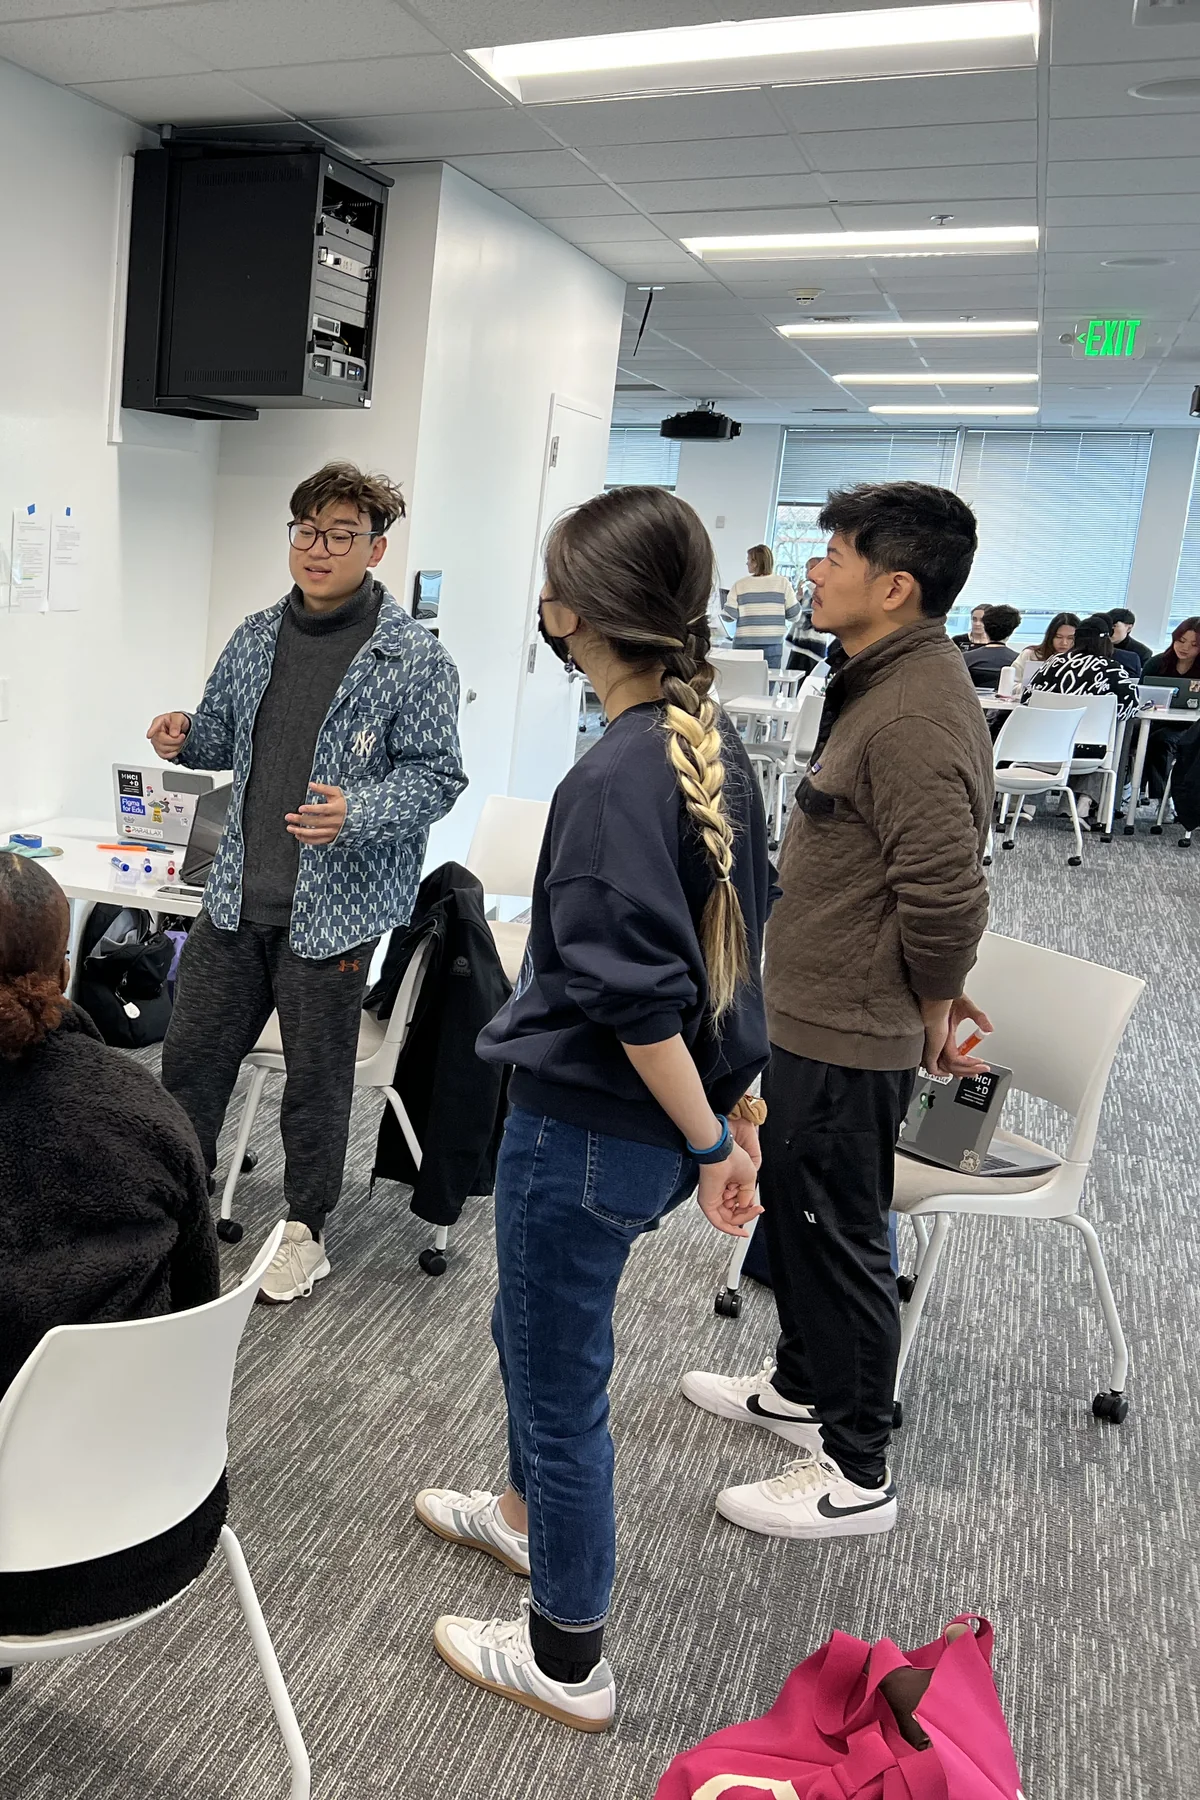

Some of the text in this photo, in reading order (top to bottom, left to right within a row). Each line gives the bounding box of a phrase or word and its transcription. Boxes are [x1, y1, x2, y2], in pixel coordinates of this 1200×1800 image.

[1085, 320, 1141, 356] EXIT
[122, 798, 140, 808] Figma
[123, 805, 145, 815] for Edu
